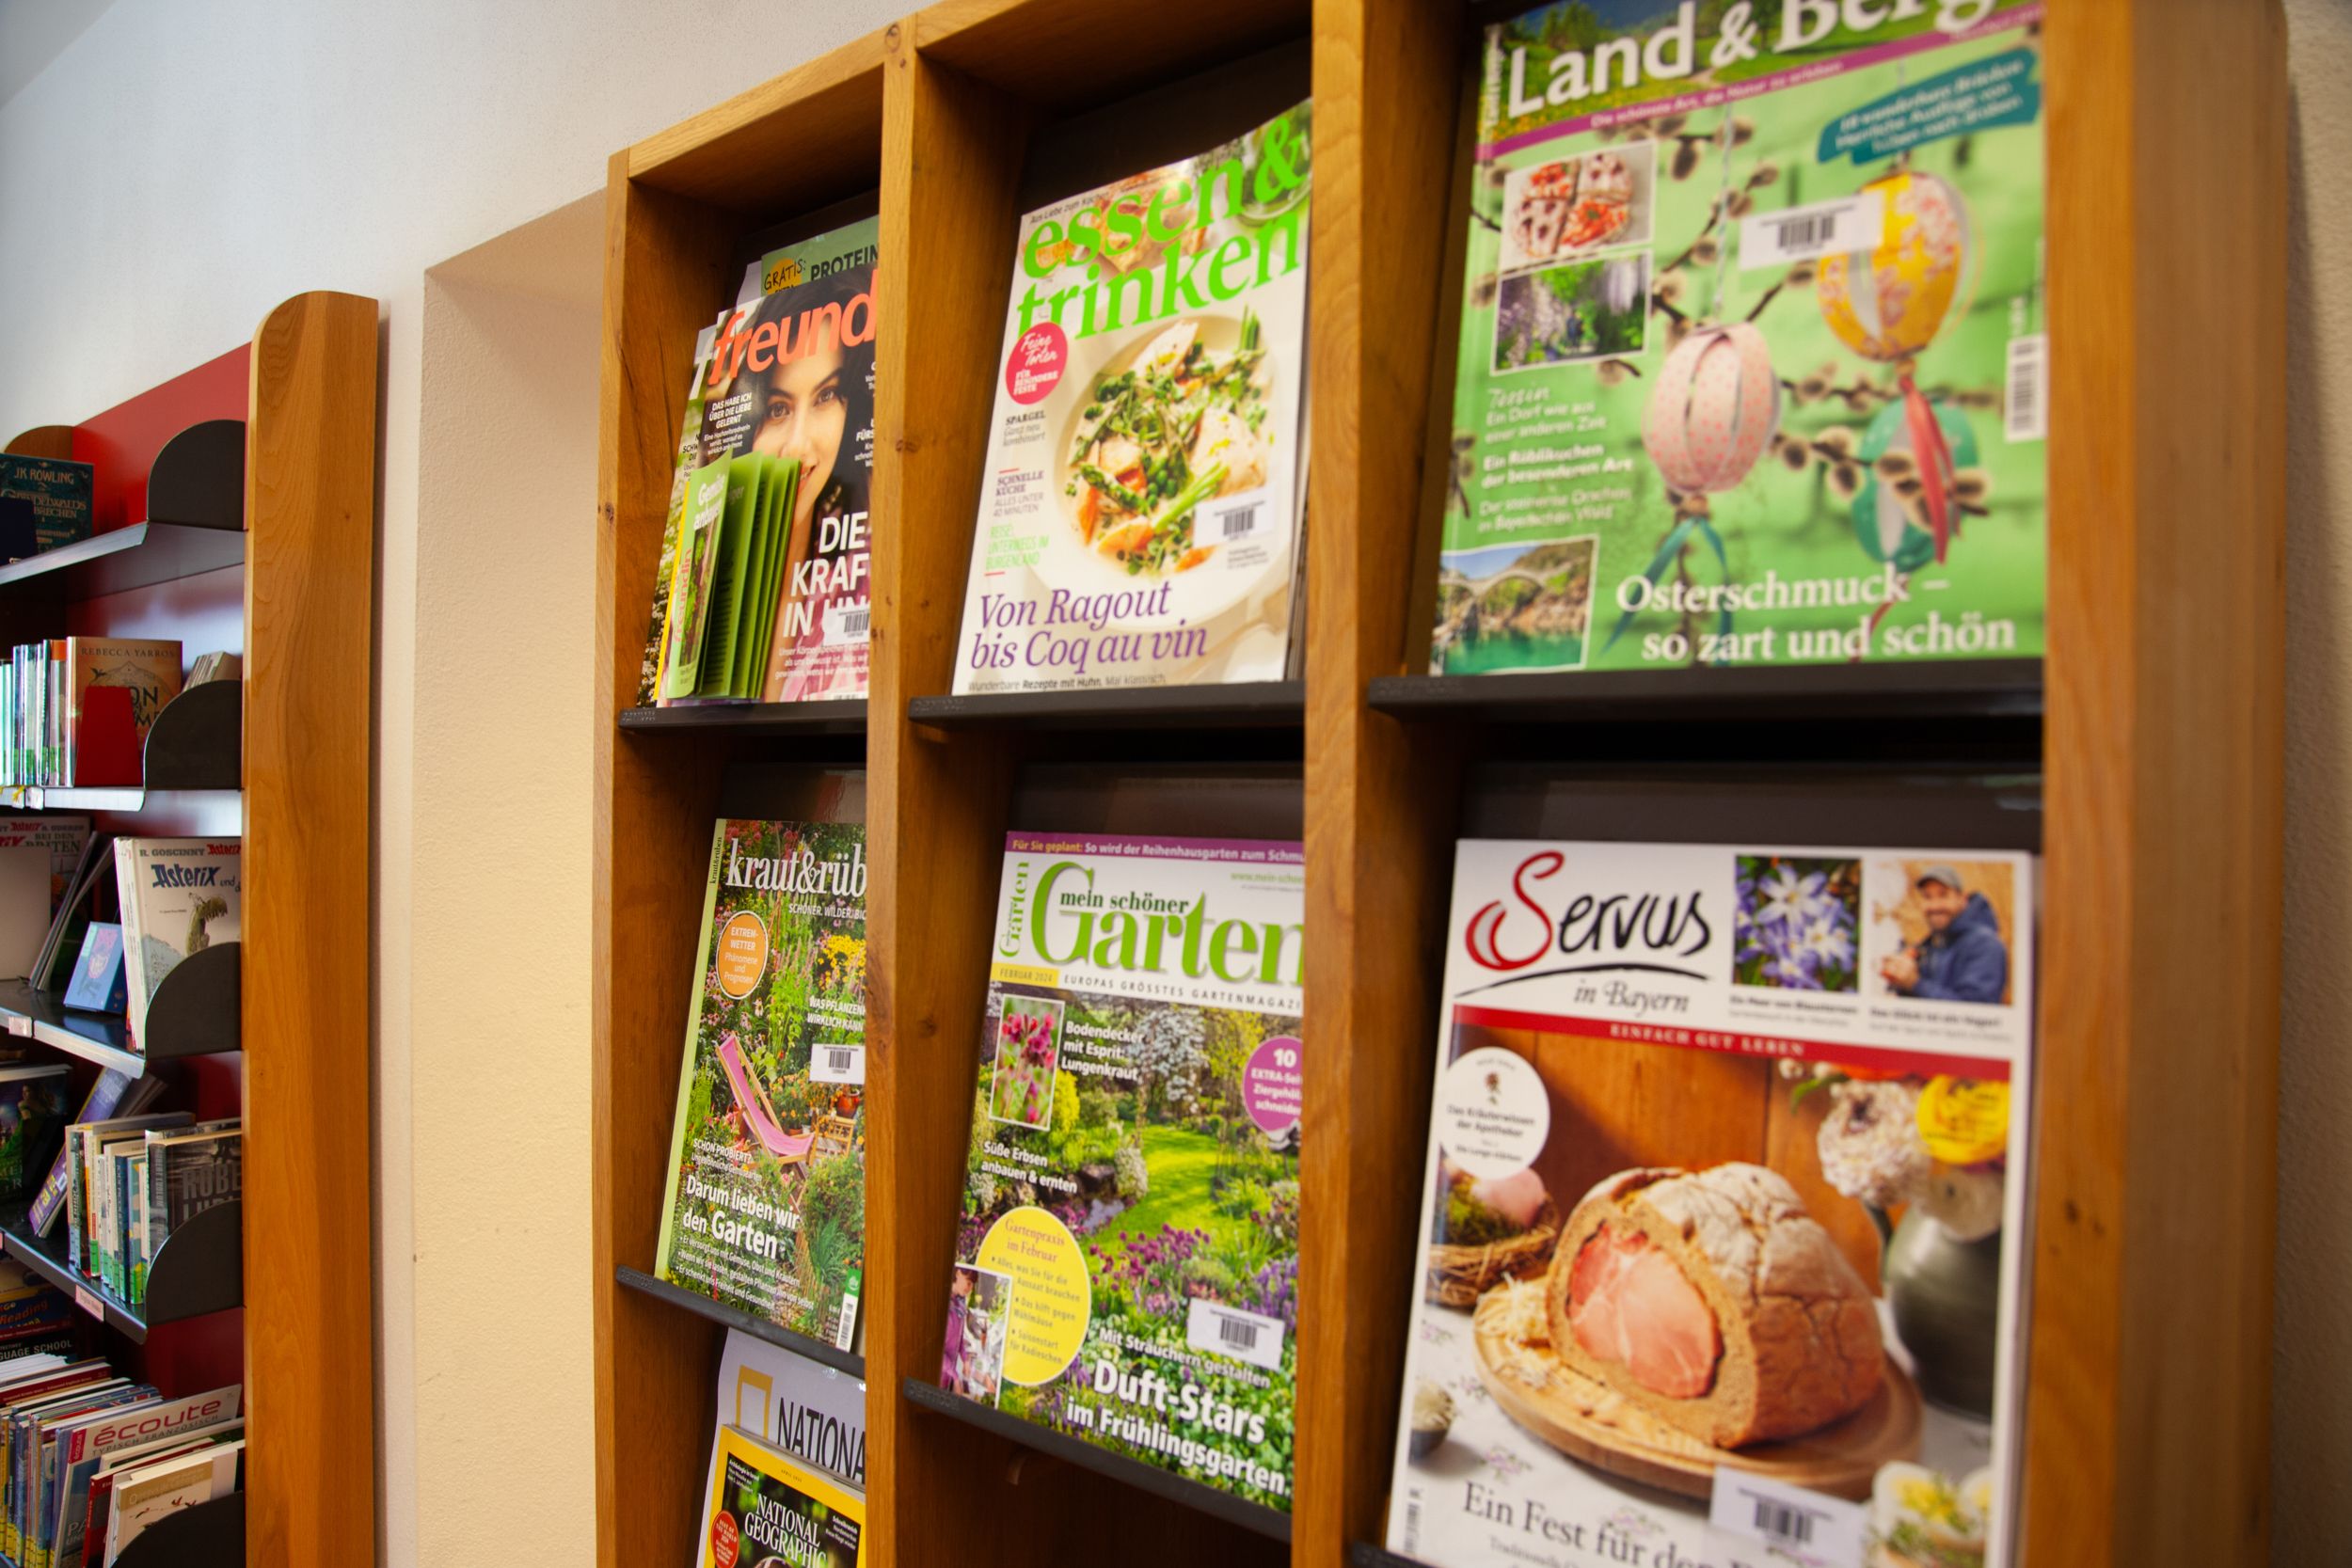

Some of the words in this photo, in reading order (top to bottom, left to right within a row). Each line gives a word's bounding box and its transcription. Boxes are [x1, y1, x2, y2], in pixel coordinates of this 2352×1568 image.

[1508, 2, 1694, 119] Land
[1710, 2, 1757, 68] &
[1024, 158, 1245, 279] essen
[1254, 116, 1309, 204] &
[1017, 213, 1300, 341] trinken
[707, 268, 879, 386] freund
[29, 468, 74, 485] ROWLING
[818, 512, 868, 554] DIE
[790, 553, 869, 597] KRAF
[1616, 562, 1911, 613] Osterschmuck
[783, 600, 815, 637] IN
[980, 594, 1037, 629] Von
[1044, 580, 1172, 631] Ragout
[81, 646, 131, 657] REBECCA
[970, 632, 1018, 670] bis
[1025, 630, 1090, 675] Coq
[1096, 633, 1141, 664] au
[1151, 617, 1208, 660] vin
[1642, 632, 1690, 660] so
[1696, 626, 1777, 661] zart
[1788, 614, 1873, 659] und
[1883, 610, 2016, 657] schön
[151, 847, 205, 857] GOSCINNY
[725, 837, 867, 897] kraut&rüb
[1012, 840, 1028, 851] Für
[1031, 841, 1044, 852] Sie
[1045, 842, 1083, 854] geplant:
[1085, 842, 1098, 853] So
[1099, 842, 1122, 854] wird
[1124, 844, 1141, 855] der
[1142, 844, 1238, 861] Reihenhausgarten
[1240, 850, 1266, 861] zum
[151, 863, 221, 889] Asterix
[220, 876, 236, 887] und
[1060, 888, 1104, 908] mein
[1109, 892, 1190, 914] schöner
[1465, 850, 1711, 972] Servus
[730, 940, 756, 952] WETTER
[1031, 861, 1304, 988] Garten
[1063, 974, 1114, 989] EUROPAS
[1120, 980, 1184, 997] GRÖSSTES
[1573, 977, 1597, 1005] in
[1602, 979, 1690, 1018] Bayern
[1063, 1041, 1085, 1055] mit
[1086, 1043, 1126, 1060] Esprit:
[1066, 1021, 1145, 1045] Bodendecker
[1694, 1031, 1735, 1050] GUT
[1740, 1037, 1804, 1056] LEBEN
[1273, 1048, 1297, 1069] 10
[983, 1140, 1011, 1158] Süße
[1011, 1146, 1048, 1168] Erbsen
[981, 1160, 1027, 1181] anbauen
[1028, 1169, 1038, 1184] &
[1039, 1174, 1078, 1194] ernten
[686, 1174, 730, 1207] Darum
[731, 1186, 772, 1222] lieben
[774, 1206, 801, 1230] wir
[682, 1206, 708, 1235] den
[710, 1209, 778, 1260] Garten
[1021, 1240, 1059, 1263] Februar
[34, 1339, 72, 1354] SCHOOL
[1099, 1326, 1124, 1346] Mit
[1125, 1333, 1202, 1368] Sträuchern
[1203, 1357, 1271, 1389] gestalten
[93, 1398, 222, 1447] écoute
[1093, 1357, 1266, 1446] Duft-Stars
[1067, 1396, 1094, 1428] im
[1099, 1407, 1286, 1496] Frühlingsgarten
[755, 1492, 821, 1549] NATIONAL
[1463, 1480, 1515, 1525] Ein
[1522, 1497, 1588, 1551] Fest
[1596, 1524, 1646, 1567] für
